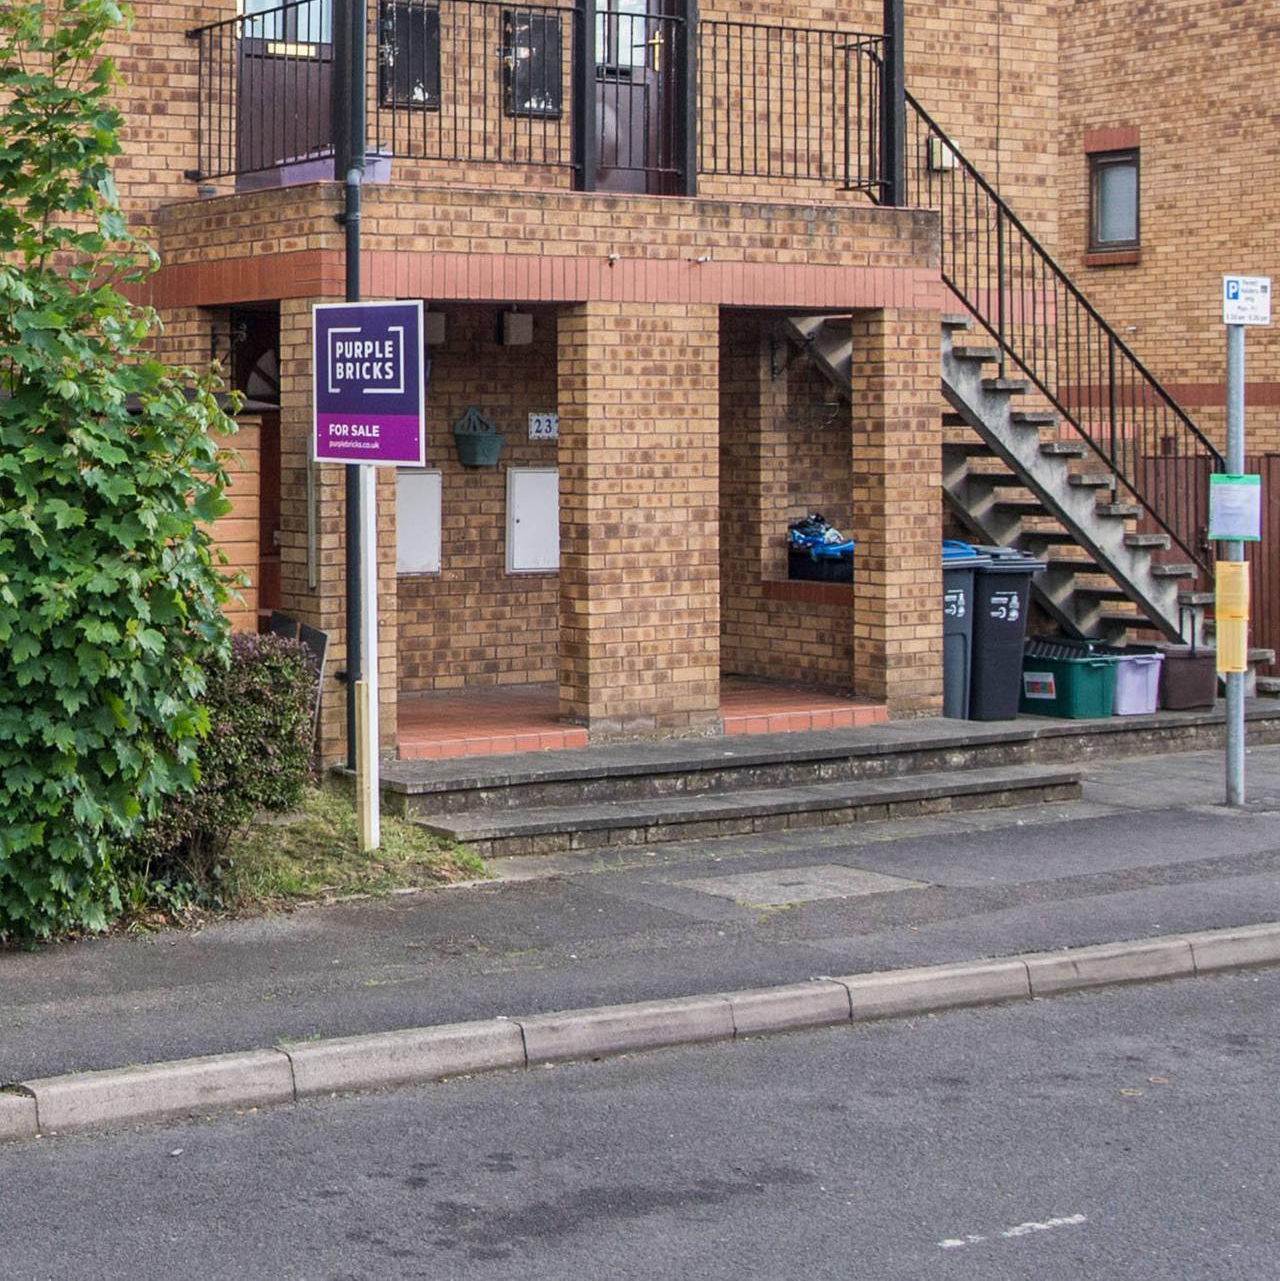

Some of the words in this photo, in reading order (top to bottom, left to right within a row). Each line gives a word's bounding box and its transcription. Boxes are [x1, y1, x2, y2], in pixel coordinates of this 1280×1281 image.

[336, 341, 394, 359] PURPLE
[336, 362, 394, 380] BRICKS
[329, 424, 349, 436] FOR
[351, 424, 380, 437] SALE
